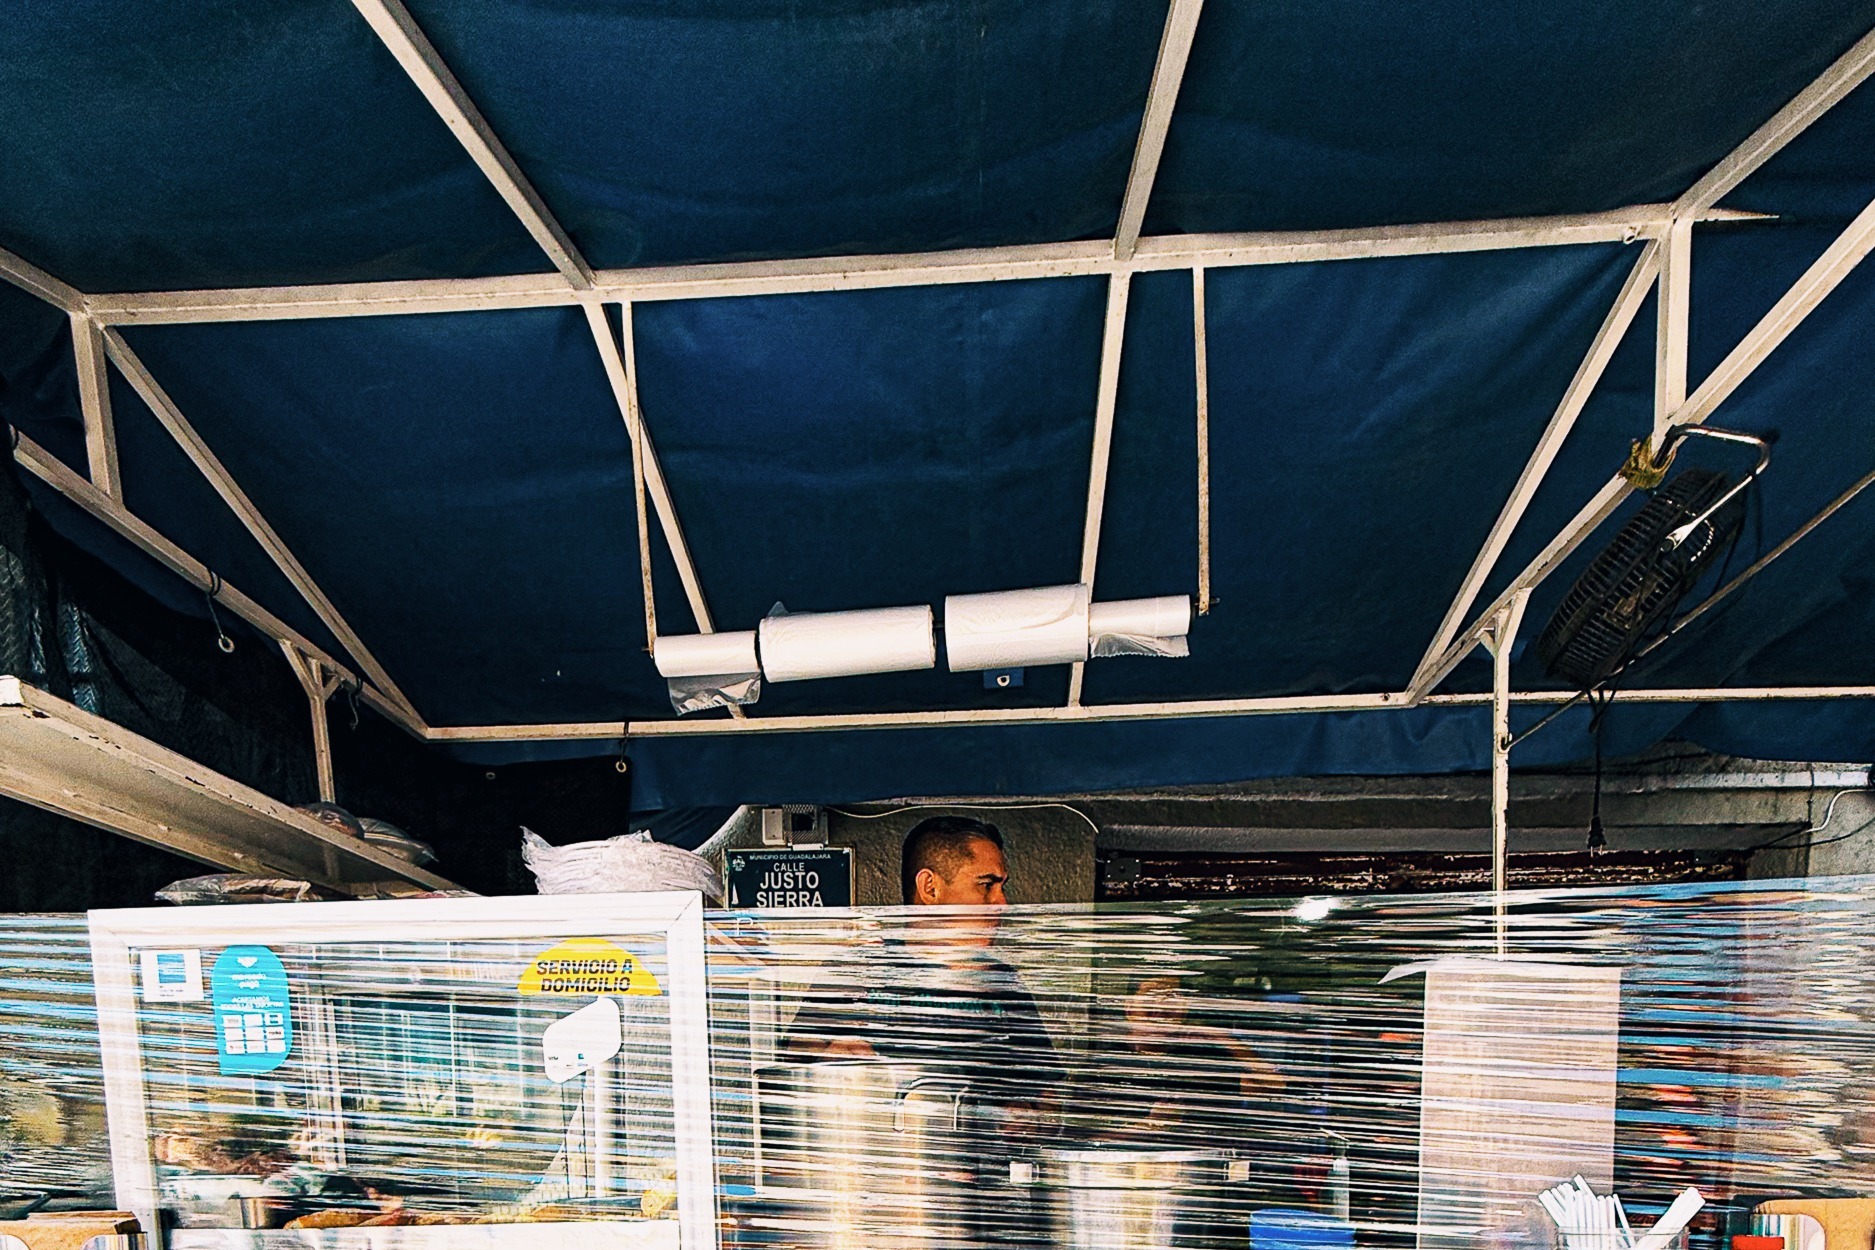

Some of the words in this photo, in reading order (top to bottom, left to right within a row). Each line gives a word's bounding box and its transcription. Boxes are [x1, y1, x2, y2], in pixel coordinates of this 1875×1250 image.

[773, 862, 805, 872] CALLE
[759, 871, 819, 889] JUSTO
[756, 891, 824, 907] SIERRA
[537, 958, 618, 975] SERVICIO
[620, 958, 633, 974] A
[541, 976, 631, 992] DOMICILIO
